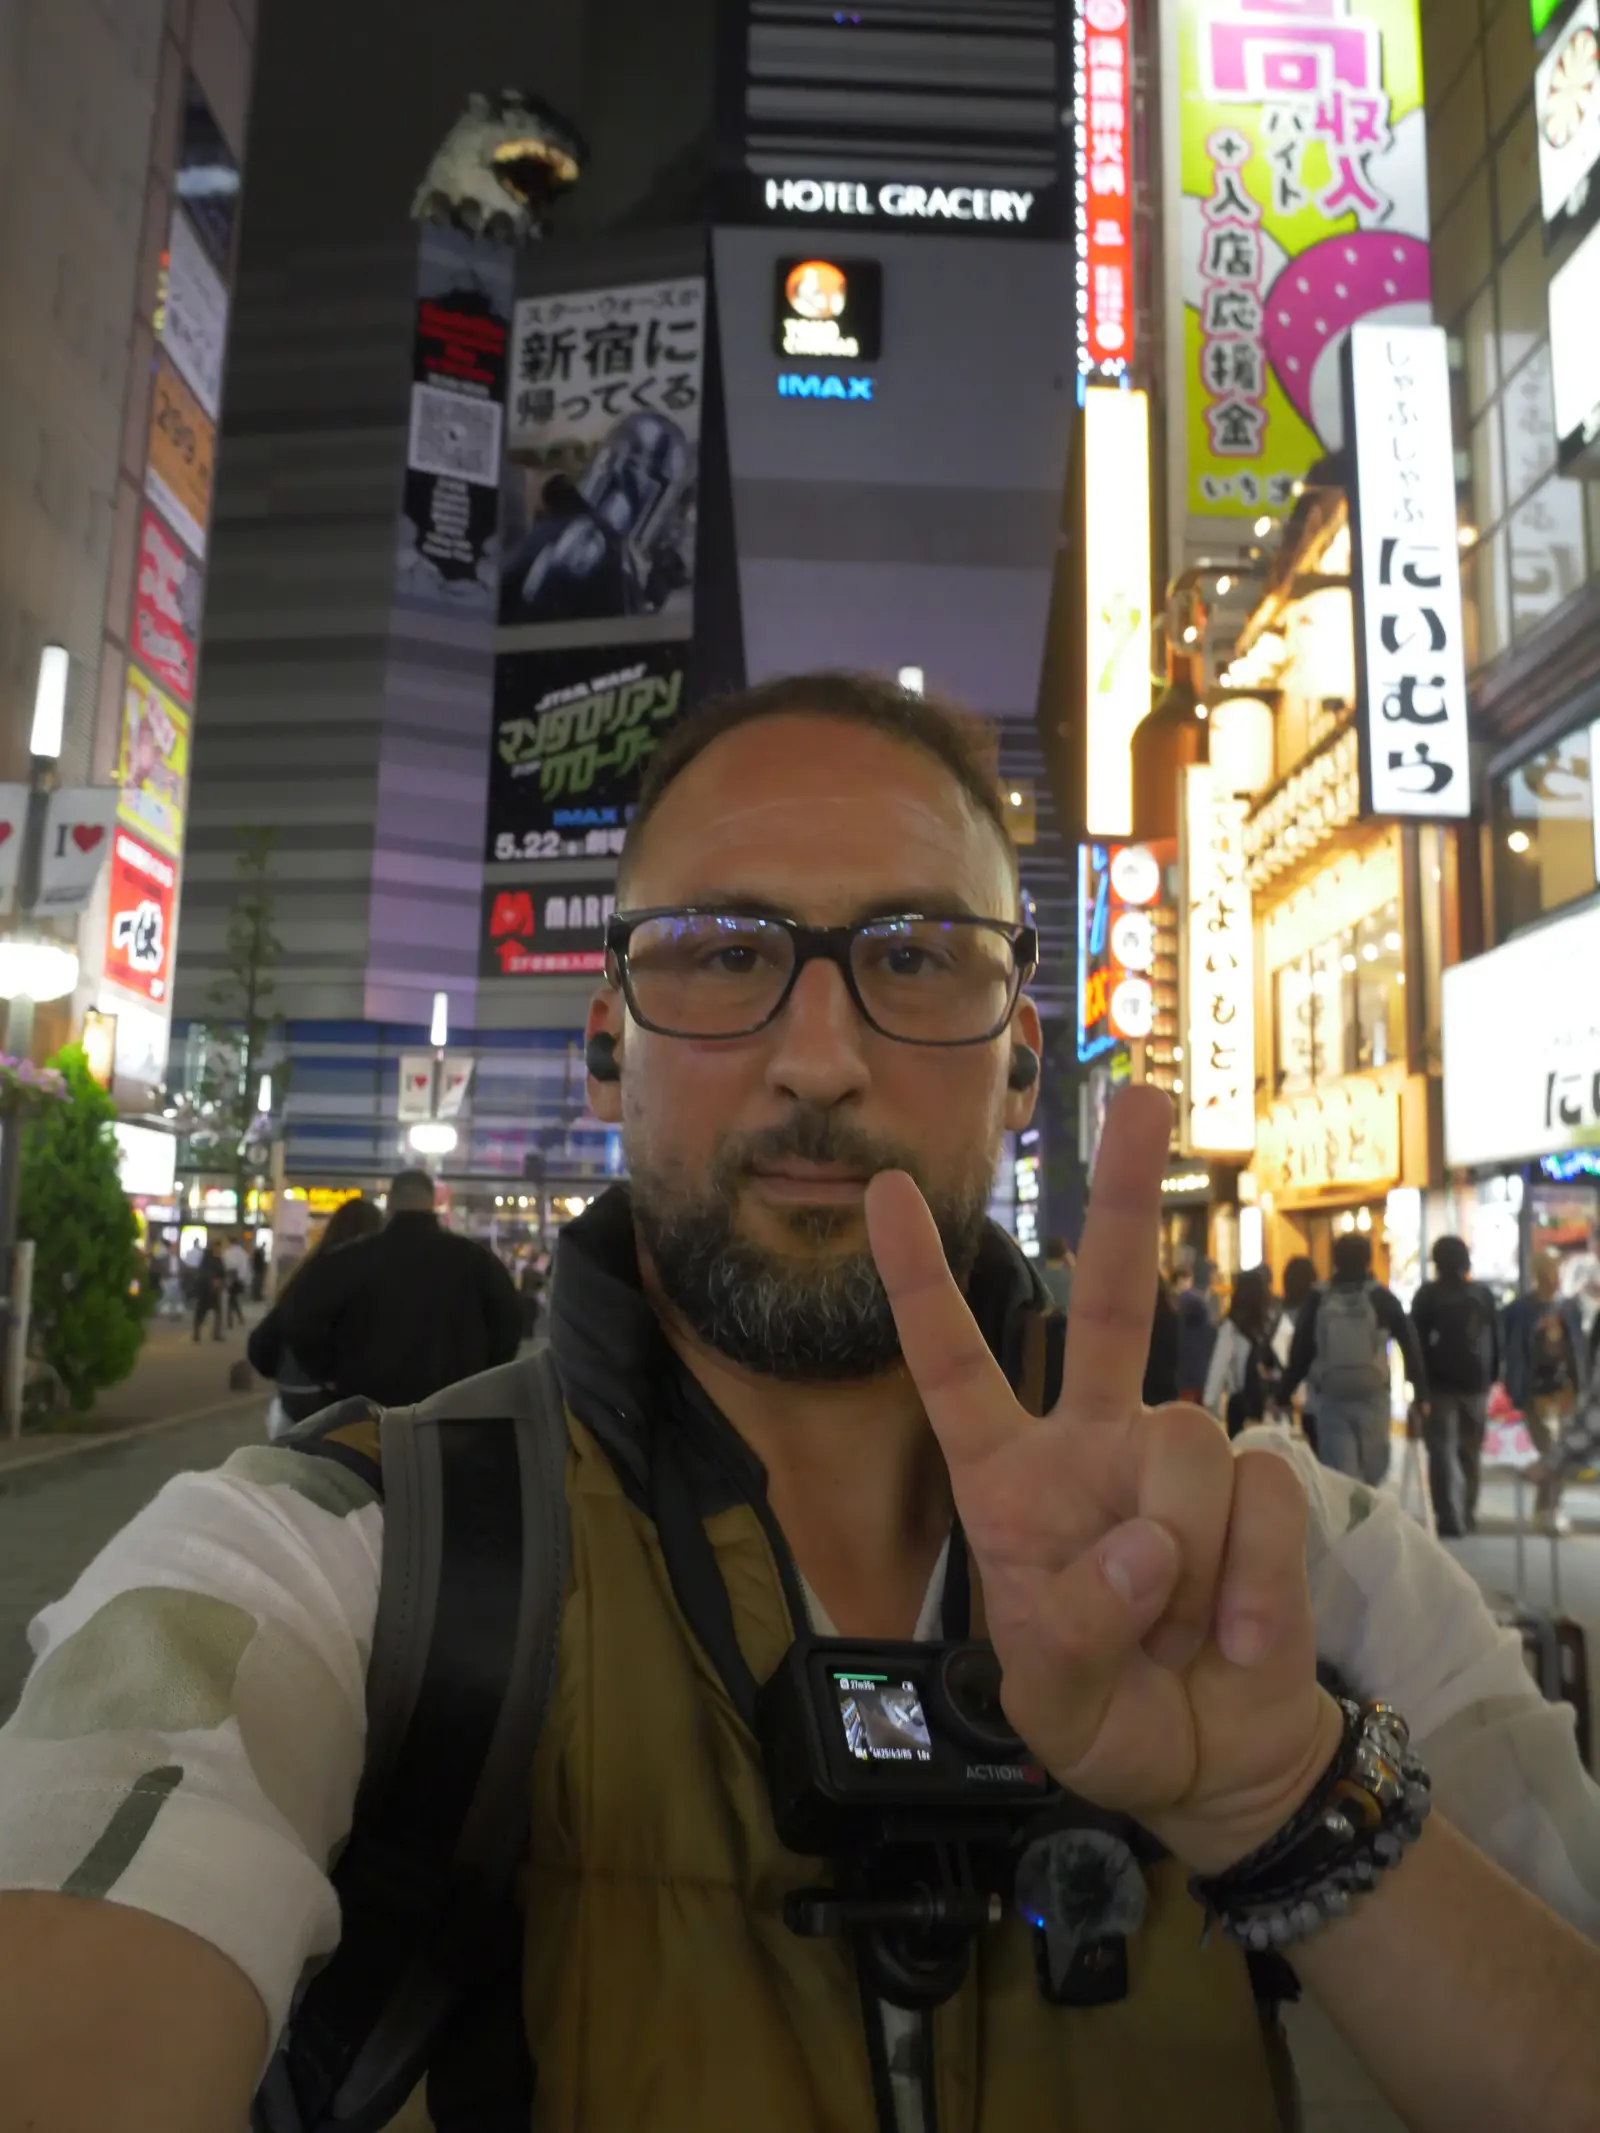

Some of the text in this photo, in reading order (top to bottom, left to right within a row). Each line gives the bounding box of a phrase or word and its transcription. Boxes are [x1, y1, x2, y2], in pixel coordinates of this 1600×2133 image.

[765, 178, 1034, 223] HOTEL GRACERY
[519, 317, 697, 384] 新宿に
[777, 373, 873, 401] IMAX
[1379, 339, 1455, 796] しゃぶしゃぶ にいむら
[553, 807, 617, 827] IMAX
[54, 823, 68, 858] I
[495, 829, 560, 860] 5.22
[966, 1764, 1024, 1780] ACTION
